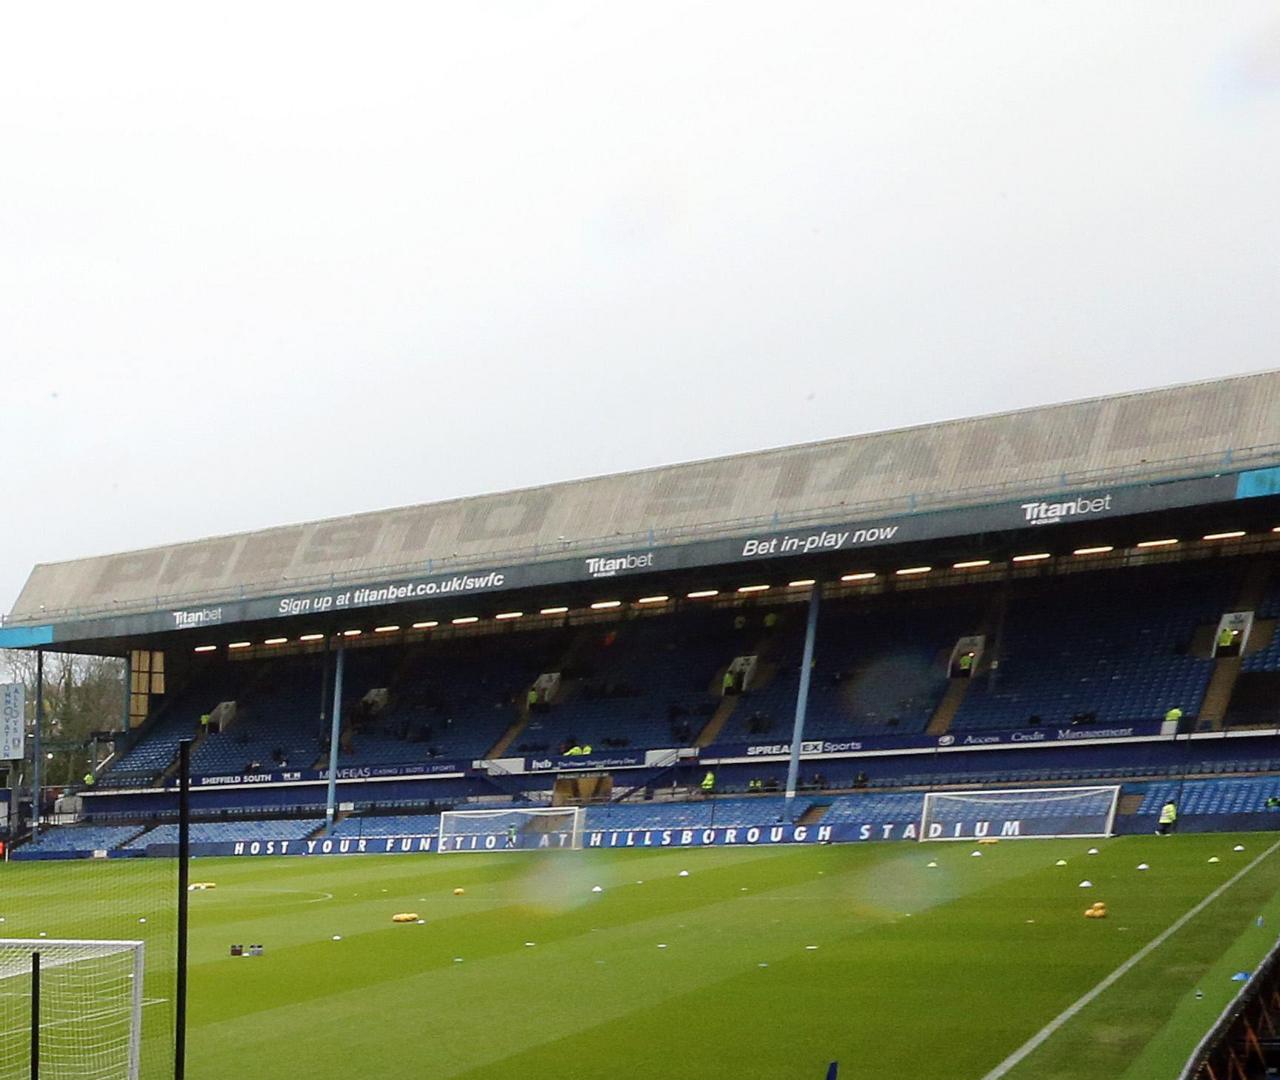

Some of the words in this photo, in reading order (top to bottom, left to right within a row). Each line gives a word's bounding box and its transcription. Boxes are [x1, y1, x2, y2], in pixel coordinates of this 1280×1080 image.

[1020, 493, 1113, 520] Titanbet
[742, 536, 778, 556] Bet
[780, 530, 847, 553] in-play
[852, 525, 898, 543] now
[586, 552, 654, 574] Titanbet
[278, 598, 310, 615] Sign
[313, 596, 332, 612] up
[335, 592, 351, 606] at
[353, 571, 505, 603] titanbet.co.uk/swfc
[172, 607, 222, 625] Titanbet
[746, 741, 824, 756] SPREAEX
[823, 741, 863, 752] Sports
[202, 775, 241, 785] SHEFFIELD
[243, 773, 272, 783] SOUTH
[234, 840, 289, 855] HOST
[307, 838, 366, 853] YOUR
[540, 832, 568, 847] AT
[589, 825, 834, 848] HILLSBOROUGH
[859, 820, 1021, 840] STADIUM
